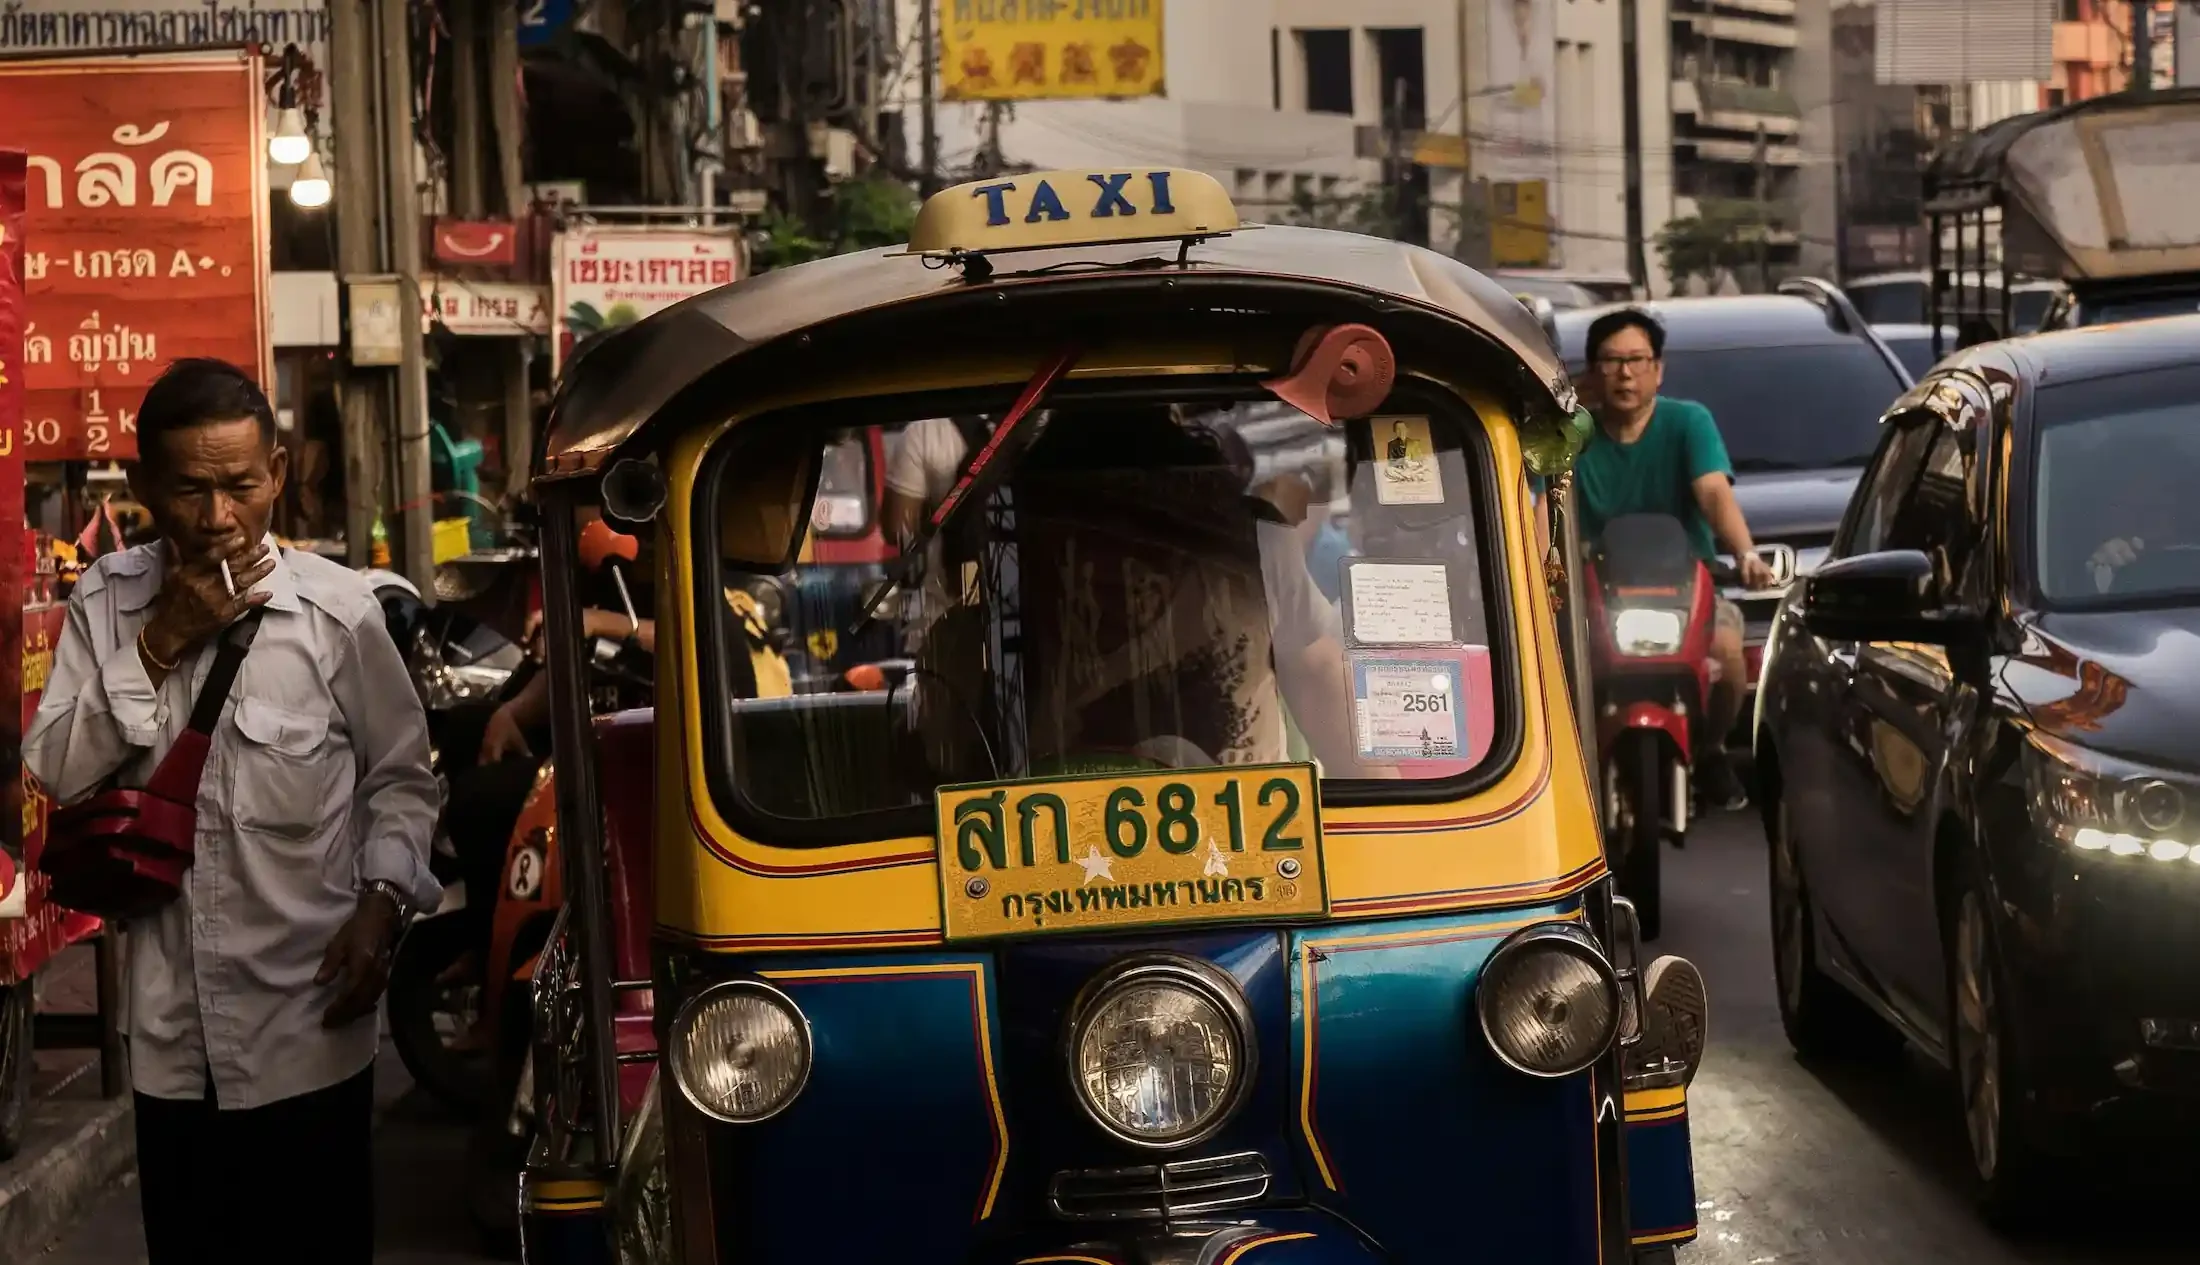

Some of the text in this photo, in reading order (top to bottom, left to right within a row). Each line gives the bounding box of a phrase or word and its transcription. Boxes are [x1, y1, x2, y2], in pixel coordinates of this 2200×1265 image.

[971, 171, 1176, 227] TAXI
[1403, 694, 1448, 712] 2561
[954, 778, 1304, 872] สก 6812
[1001, 876, 1265, 926] กรุงเทพมหานคร
